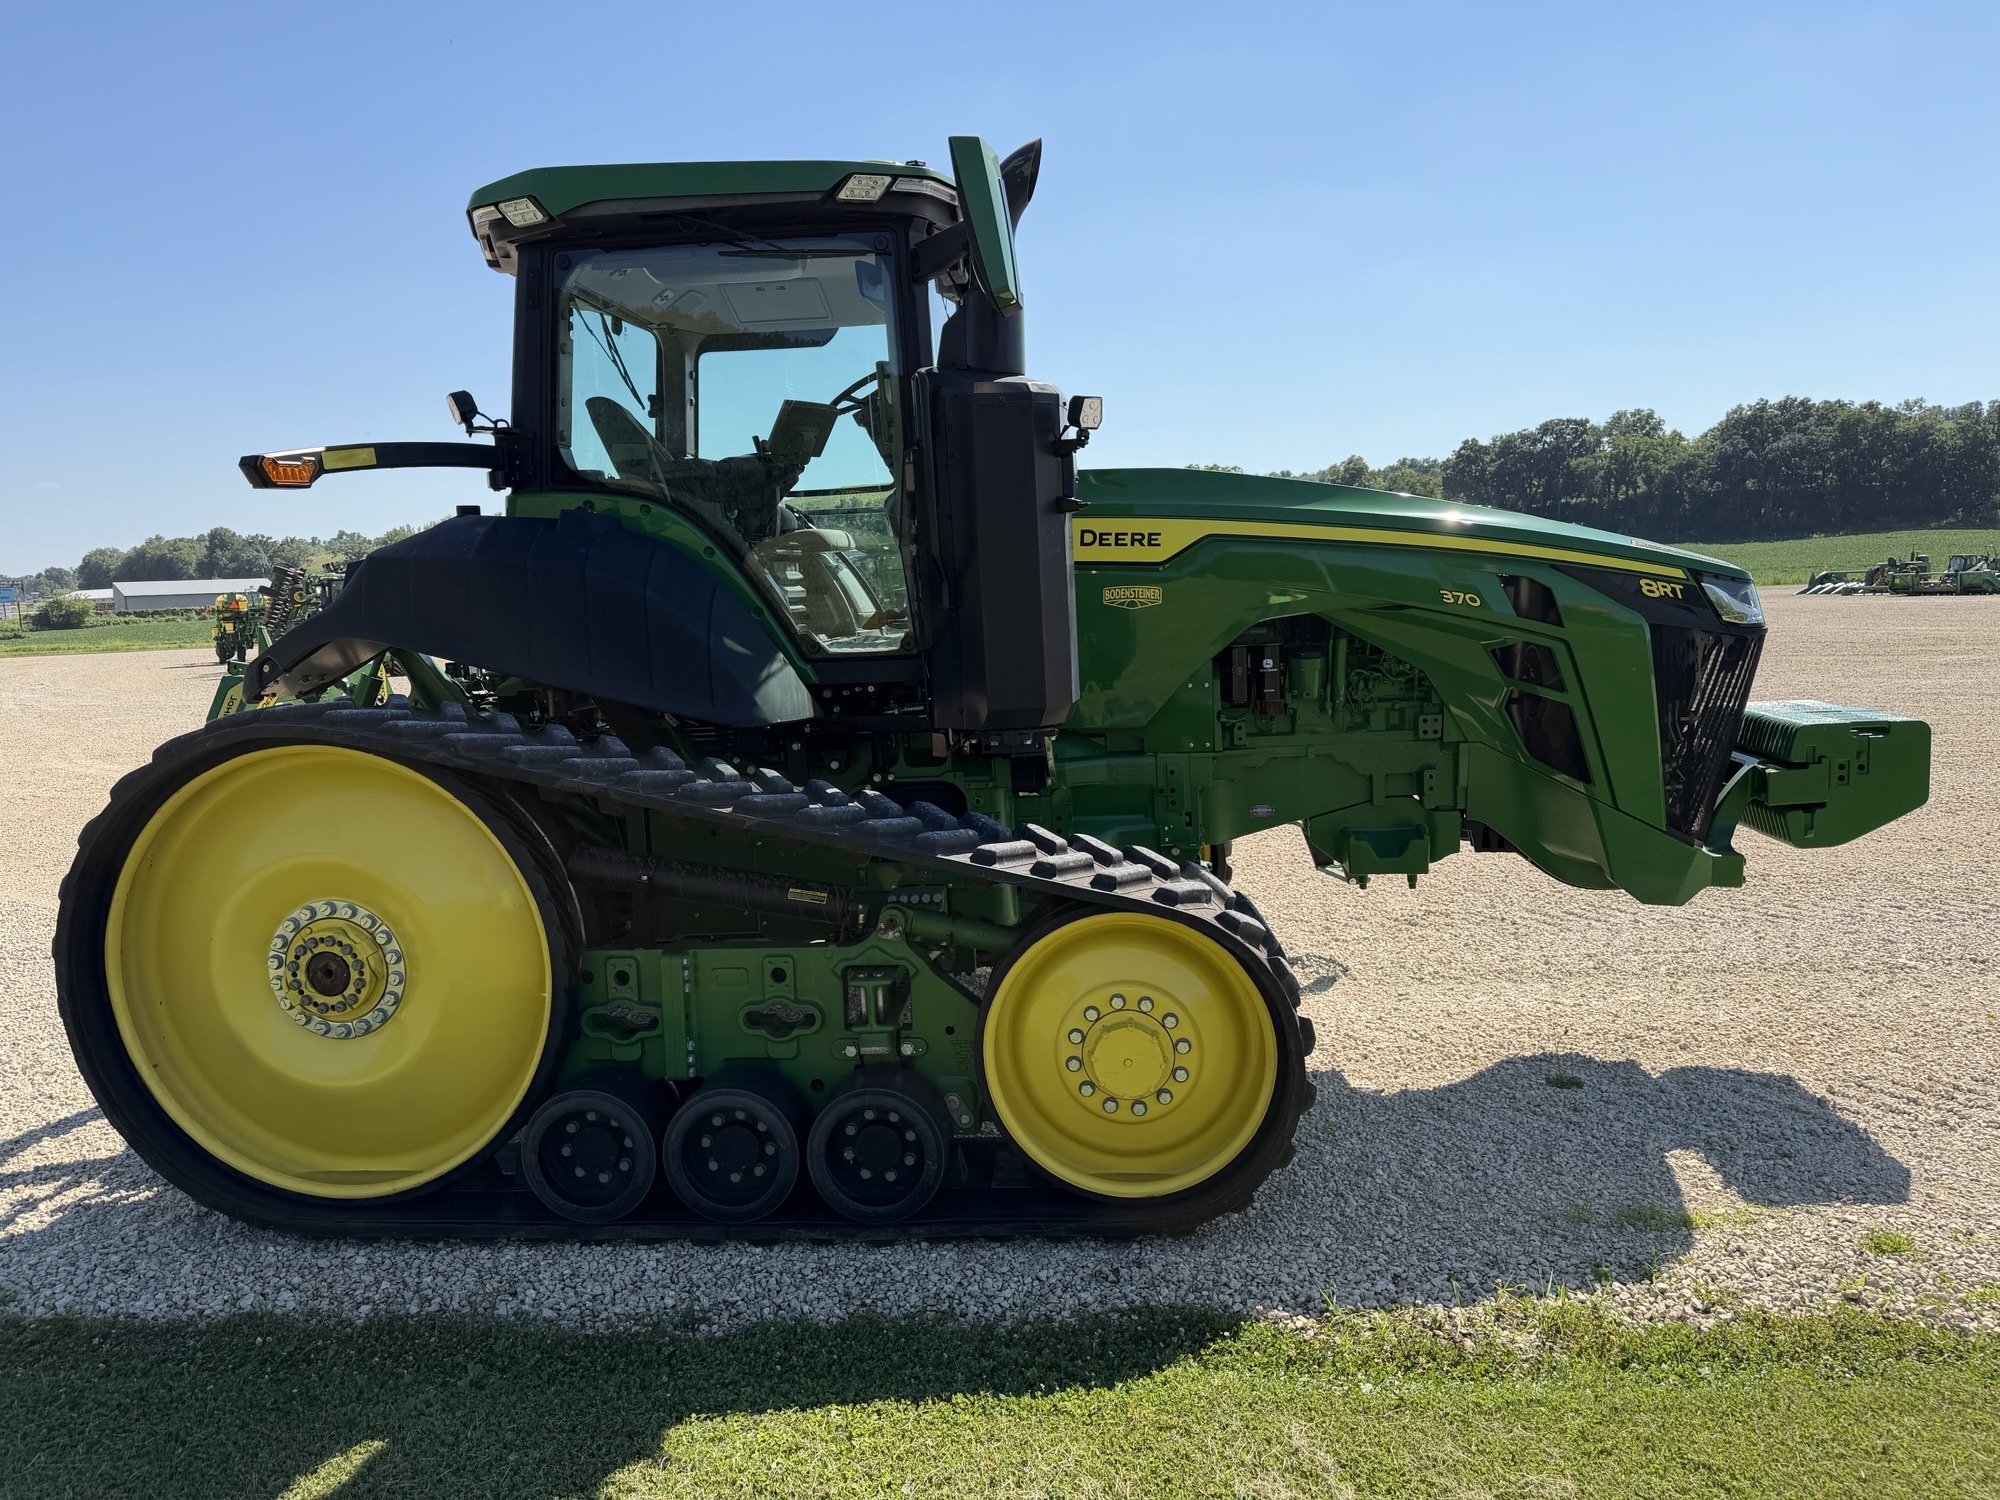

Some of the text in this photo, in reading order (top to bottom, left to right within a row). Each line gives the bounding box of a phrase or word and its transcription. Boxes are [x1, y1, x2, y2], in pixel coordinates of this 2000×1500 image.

[1080, 529, 1162, 547] DEERE
[1105, 588, 1160, 600] BODENSTEINER
[1639, 578, 1684, 599] 8RT
[1439, 589, 1481, 607] 370
[223, 695, 238, 715] JOH
